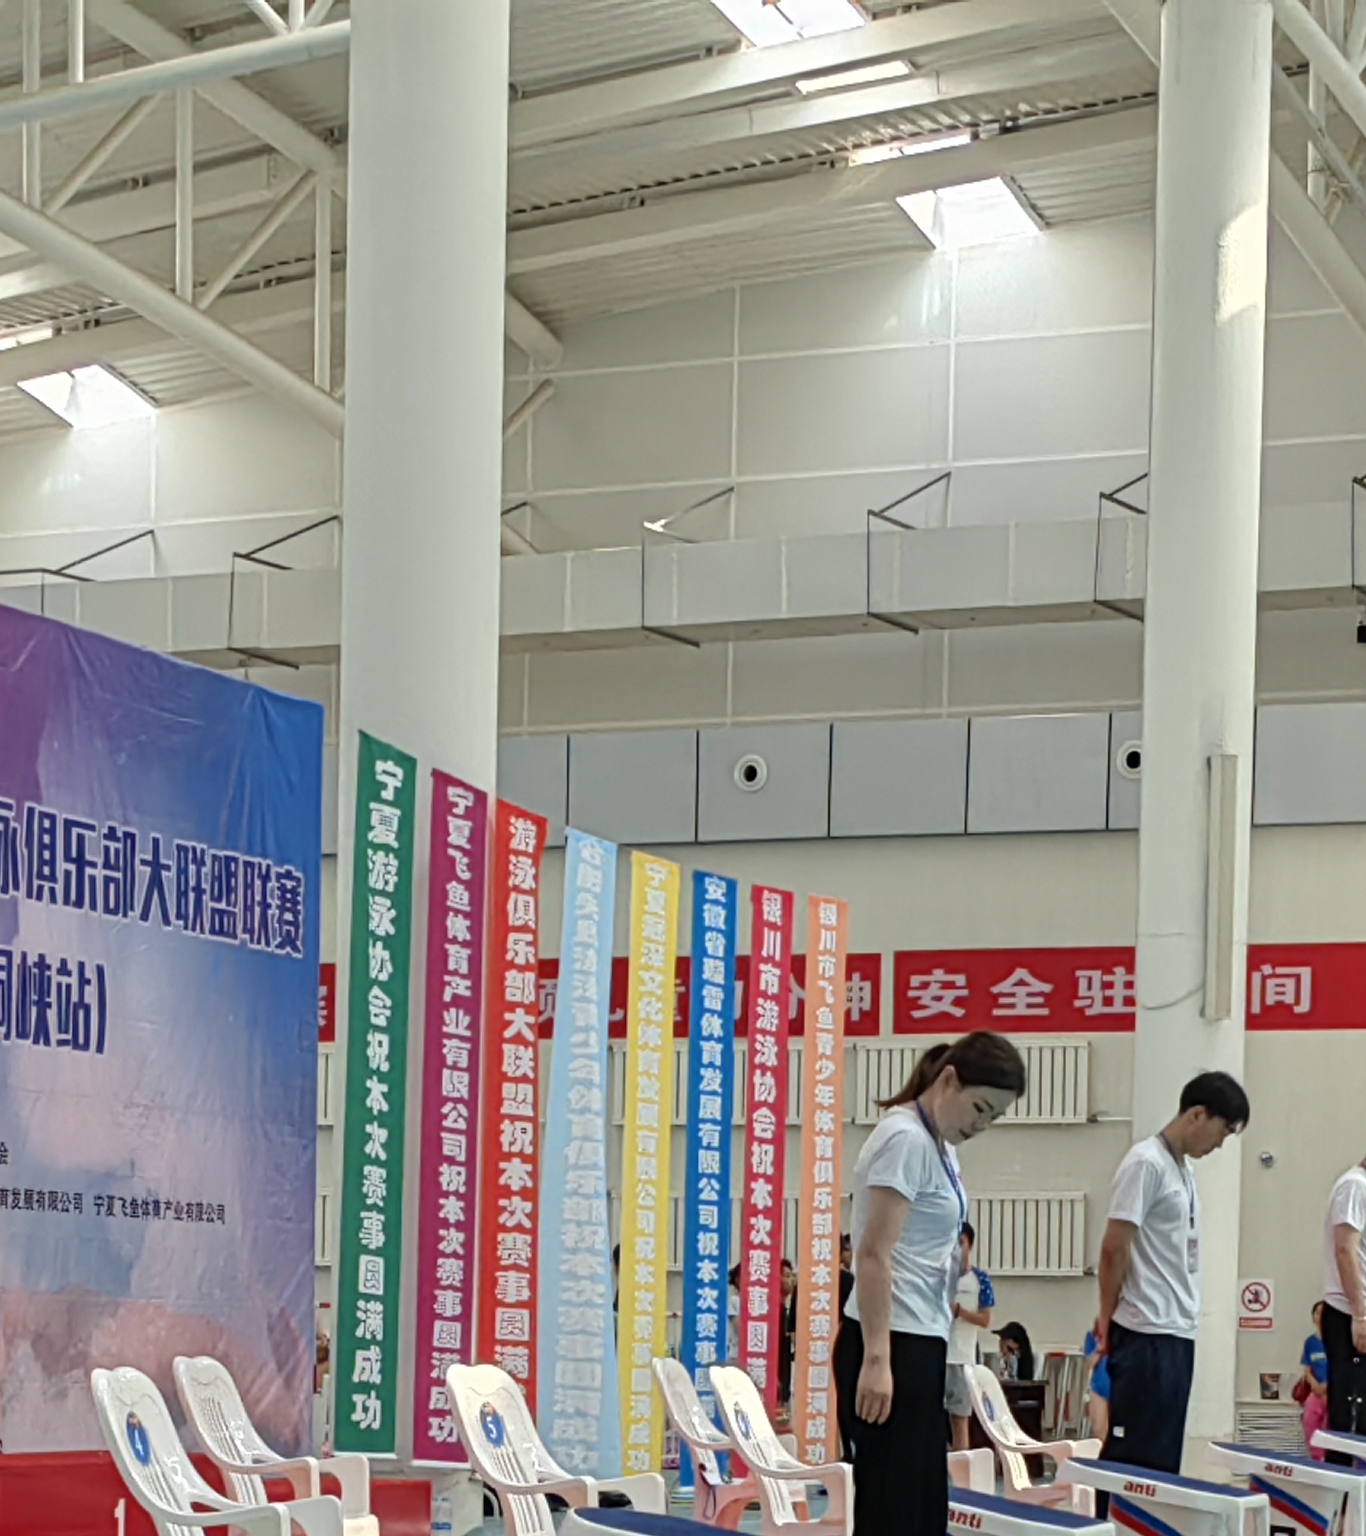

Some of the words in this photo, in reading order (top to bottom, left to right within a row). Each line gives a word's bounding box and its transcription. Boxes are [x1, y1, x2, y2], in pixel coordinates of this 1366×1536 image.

[349, 758, 405, 1432] 宁夏游泳协会祝本次赛事圆满成功
[493, 814, 537, 1396] 游泳俱乐部大联盟祝本次赛事圆满
[485, 1416, 498, 1439] 5
[1264, 1462, 1294, 1478] anti
[1123, 1480, 1157, 1498] anti
